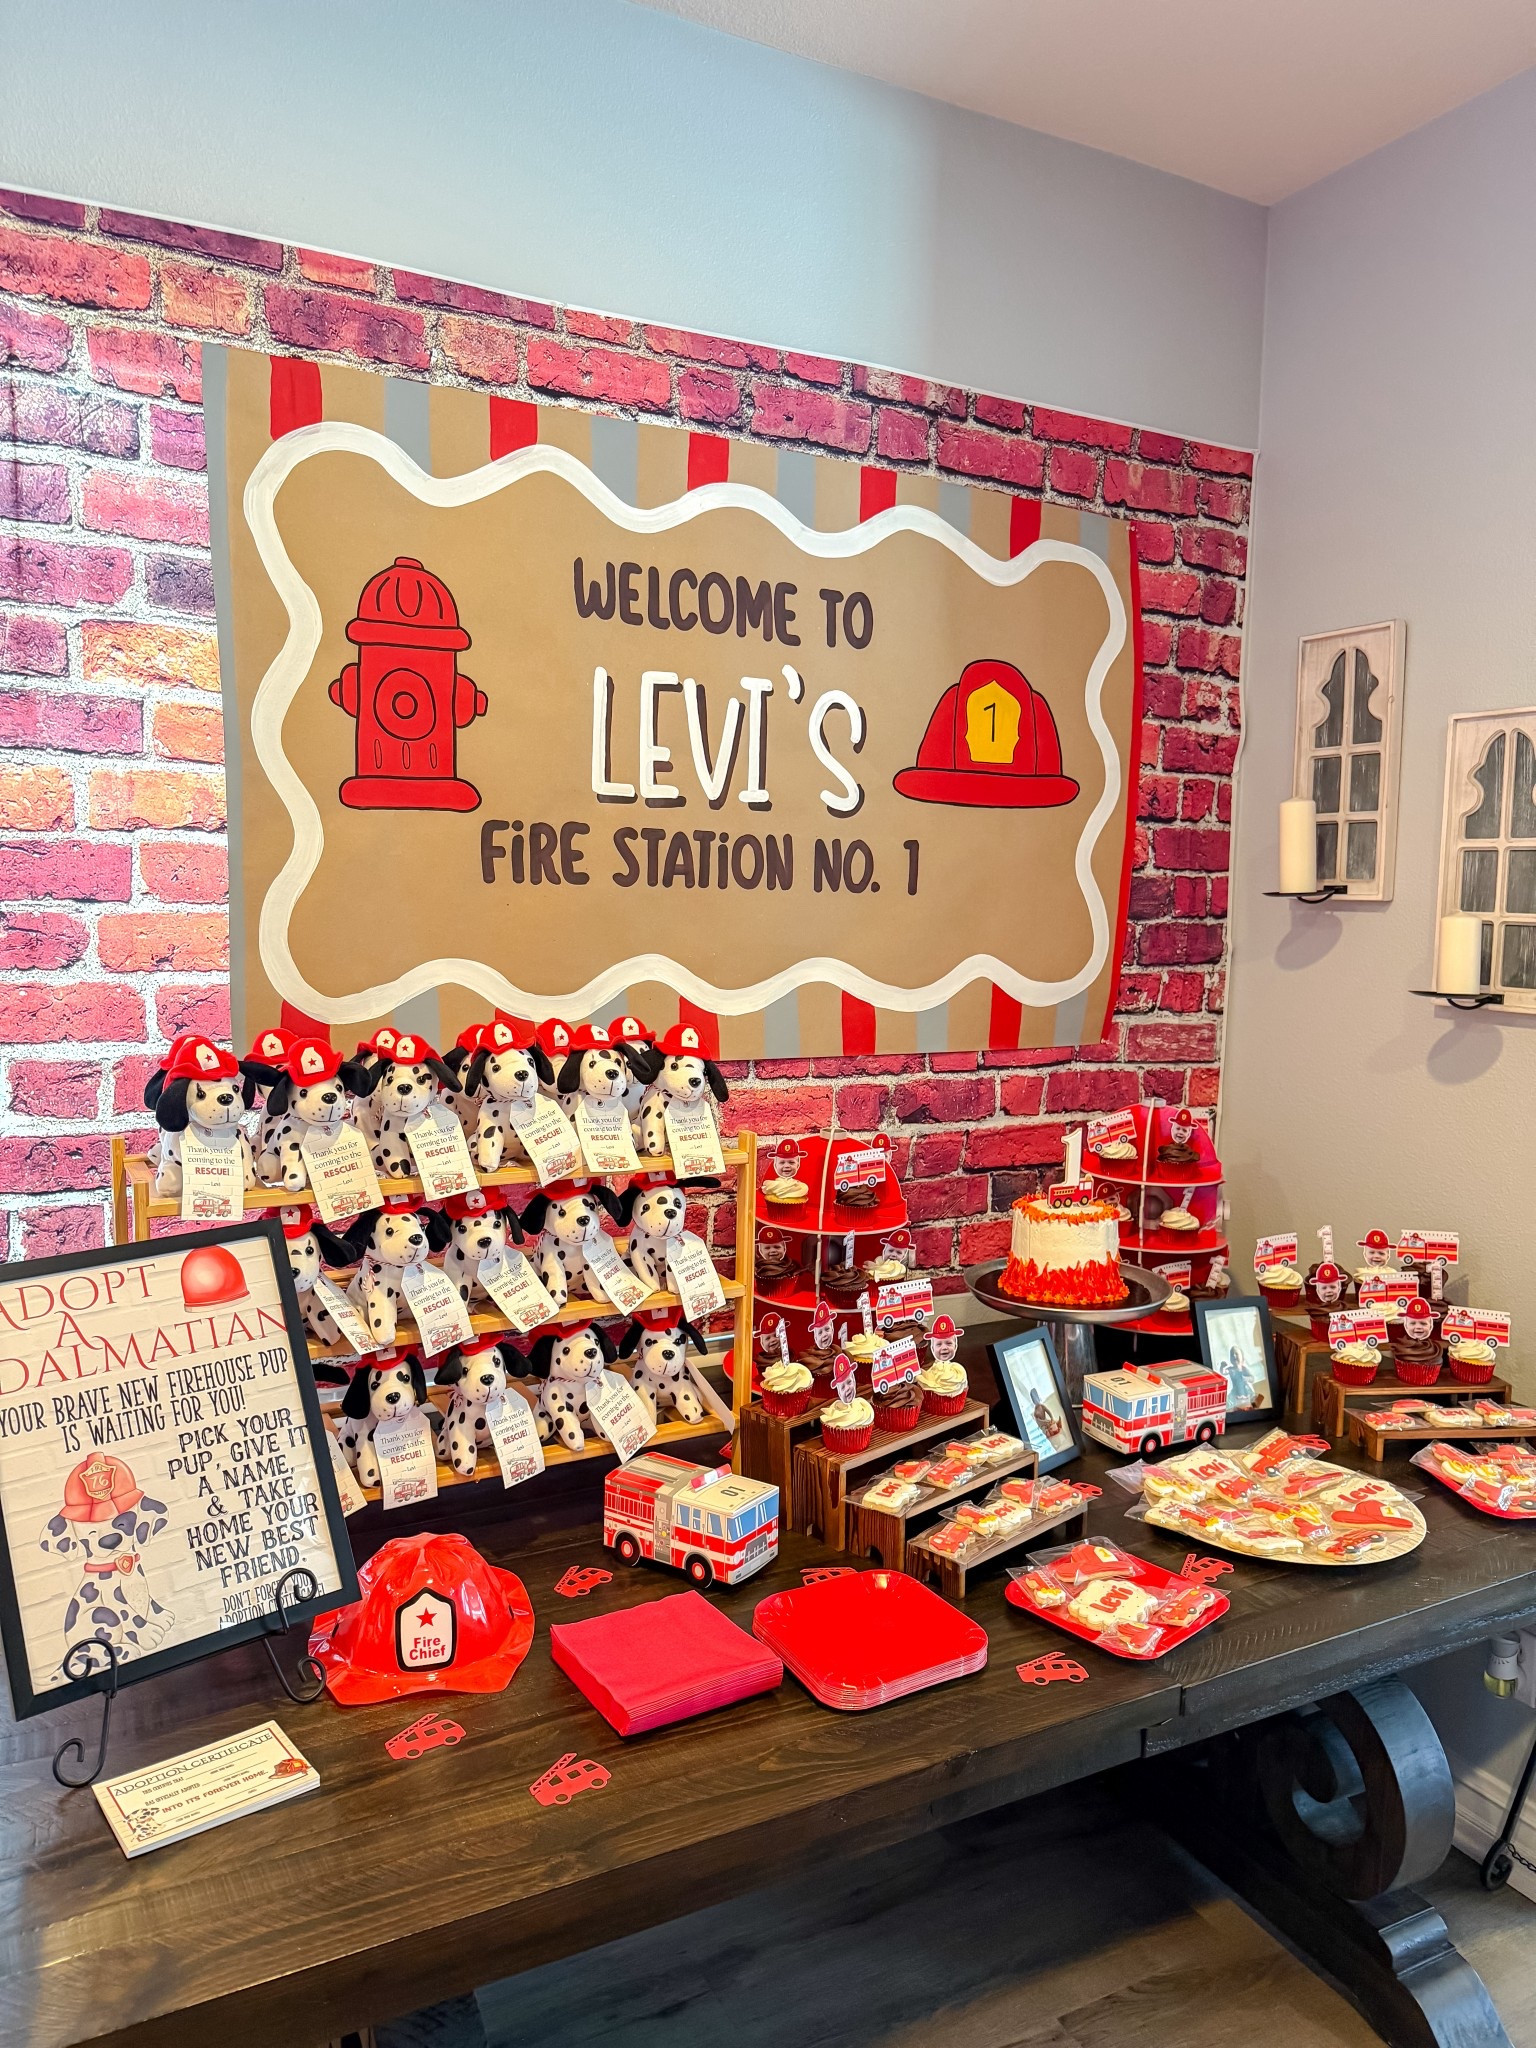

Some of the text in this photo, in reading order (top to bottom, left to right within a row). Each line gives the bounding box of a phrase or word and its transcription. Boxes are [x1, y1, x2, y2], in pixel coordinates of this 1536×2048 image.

[573, 556, 873, 649] WELCOME TO
[983, 702, 996, 742] 1
[591, 664, 867, 818] LEVI'S
[813, 838, 881, 893] NO.
[903, 840, 919, 895] 1
[534, 1127, 563, 1146] RESCUE!
[679, 1132, 708, 1142] RESCUE!
[311, 1141, 358, 1160] Thank you for
[314, 1151, 362, 1170] coming to the
[424, 1145, 456, 1158] RESCUE!
[1061, 1127, 1082, 1187] 1
[195, 1167, 230, 1176] RESCUE!
[323, 1162, 359, 1179] RESCUE!
[684, 1267, 708, 1283] RESCUE!
[409, 1285, 428, 1297] Thank
[427, 1281, 438, 1291] you
[413, 1293, 436, 1307] coming
[442, 1285, 451, 1293] the
[502, 1280, 530, 1299] RESCUE!
[422, 1296, 451, 1315] RESCUE!
[53, 1310, 104, 1350] A
[0, 1302, 288, 1395] DALMATIAN
[0, 1347, 289, 1438] YOUR BRAVE NEW FIREHOUSE PUP
[61, 1385, 247, 1454] IS WAITING FOR YOU!
[610, 1402, 633, 1426] RESCUE!
[178, 1407, 293, 1454] PICK YOUR
[502, 1429, 528, 1446] RESCUE!
[167, 1424, 309, 1481] PUP, GIVE IT
[390, 1450, 422, 1465] RESCUE!
[198, 1454, 296, 1498] A NAME,
[1187, 1459, 1230, 1481] Levi
[206, 1476, 296, 1518] & TAKE
[875, 1482, 901, 1499] Levi
[186, 1492, 320, 1550] HOME YOUR
[993, 1502, 1017, 1519] evi
[195, 1515, 319, 1572] NEW BEST
[220, 1545, 307, 1589] FRIEND.
[222, 1573, 311, 1614] DON'T FORGT YOU
[1089, 1584, 1134, 1614] Levi
[409, 1644, 446, 1661] Chief
[413, 1636, 441, 1649] Fire
[114, 1733, 273, 1797] ADOPTION CERTIFICATE
[162, 1802, 184, 1814] INTO
[185, 1795, 201, 1805] ITS
[203, 1779, 241, 1799] FOREVER
